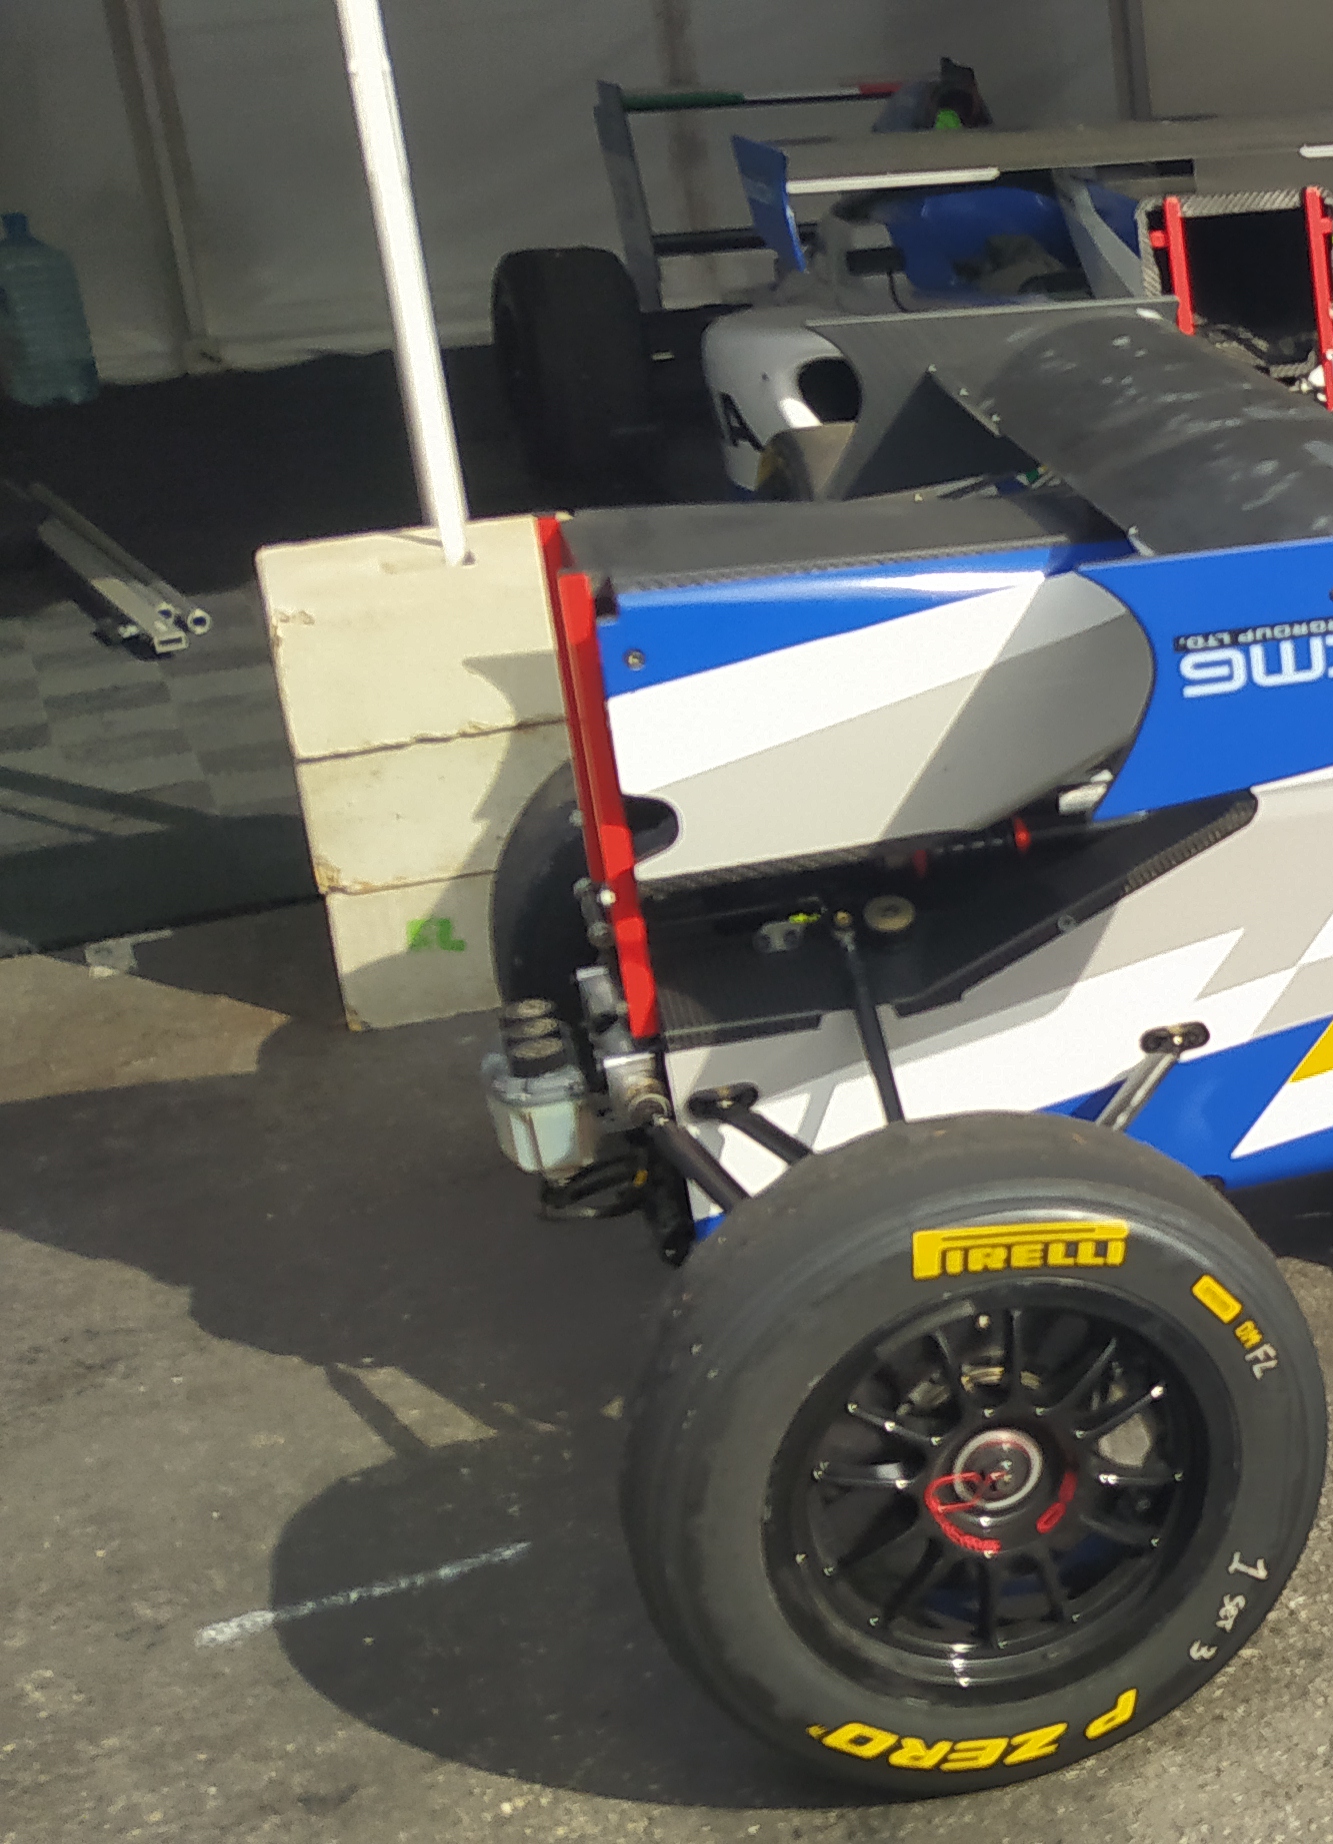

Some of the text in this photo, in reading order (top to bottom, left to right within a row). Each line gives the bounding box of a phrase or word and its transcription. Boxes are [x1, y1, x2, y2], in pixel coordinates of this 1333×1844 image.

[912, 1219, 1129, 1280] PIRELLI
[1244, 1342, 1279, 1381] FL
[1189, 1639, 1219, 1661] 3
[822, 1687, 1138, 1773] P ZERO
